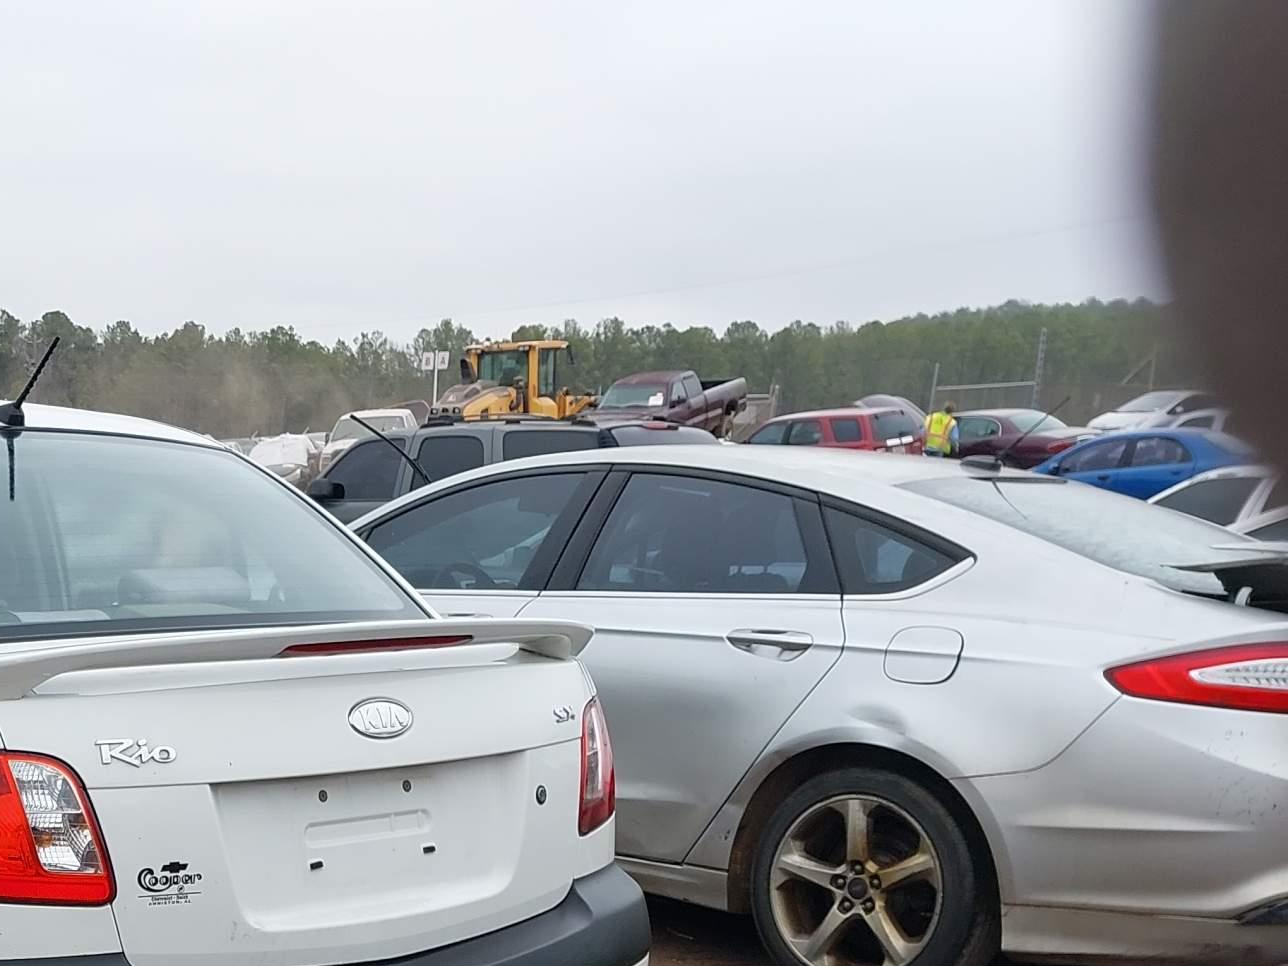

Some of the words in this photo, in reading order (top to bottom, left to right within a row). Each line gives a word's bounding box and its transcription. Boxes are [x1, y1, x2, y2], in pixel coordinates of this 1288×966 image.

[356, 705, 407, 731] KIA
[94, 738, 177, 768] Rio
[137, 867, 202, 893] Cooper
